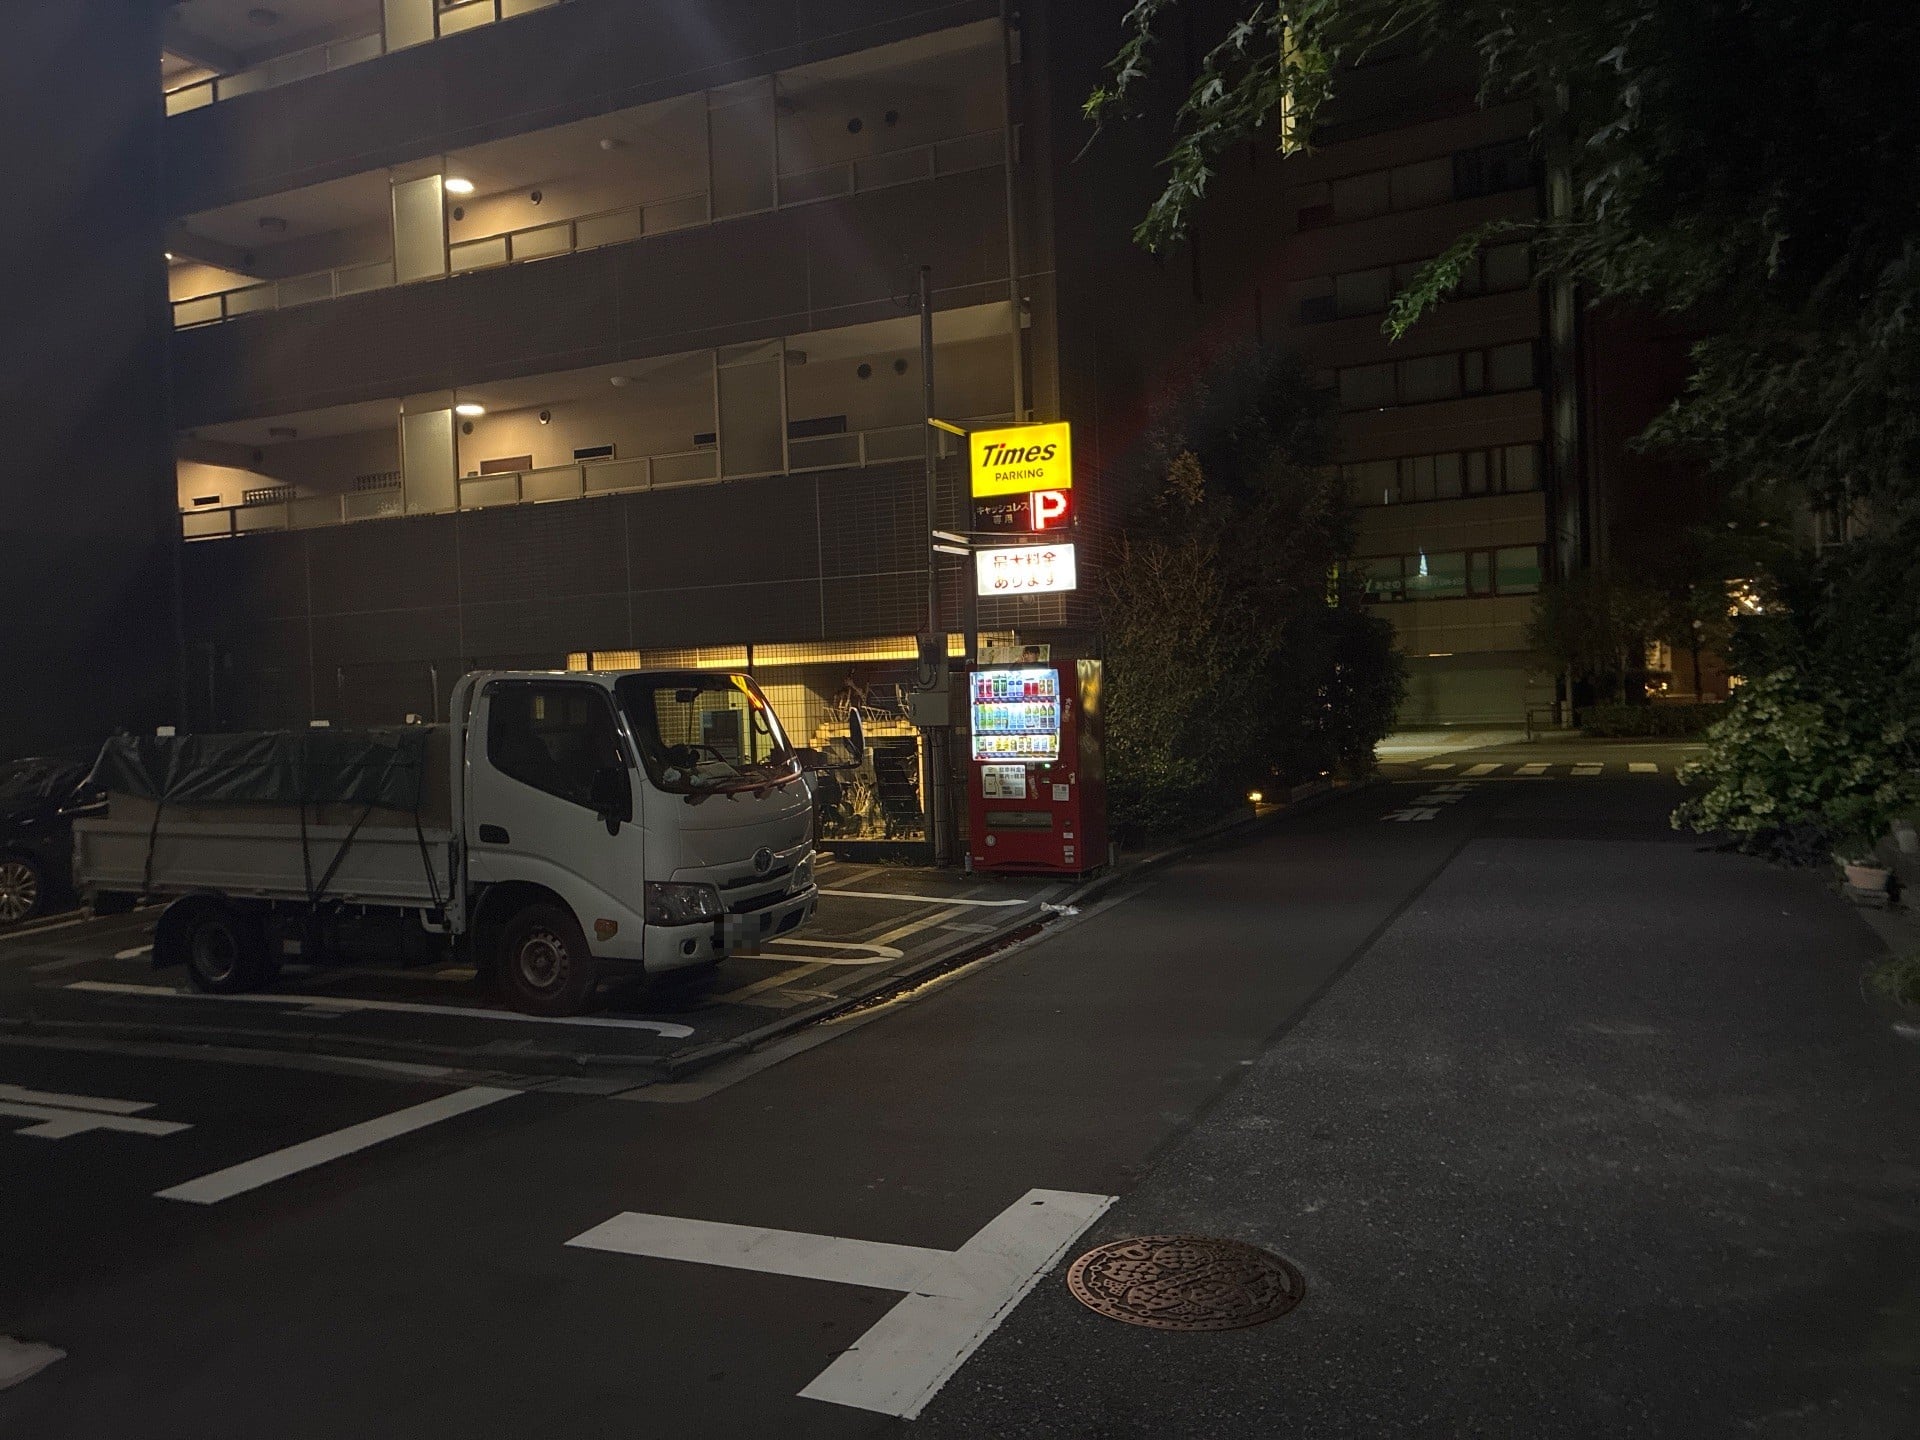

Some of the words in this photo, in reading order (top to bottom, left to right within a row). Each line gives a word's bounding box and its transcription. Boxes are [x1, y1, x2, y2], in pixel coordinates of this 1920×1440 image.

[983, 443, 1057, 467] Times
[995, 468, 1044, 481] PARKING
[976, 501, 1030, 515] キャッシュレス
[1036, 491, 1067, 529] P
[992, 513, 1014, 525] 専用
[994, 573, 1054, 589] あります
